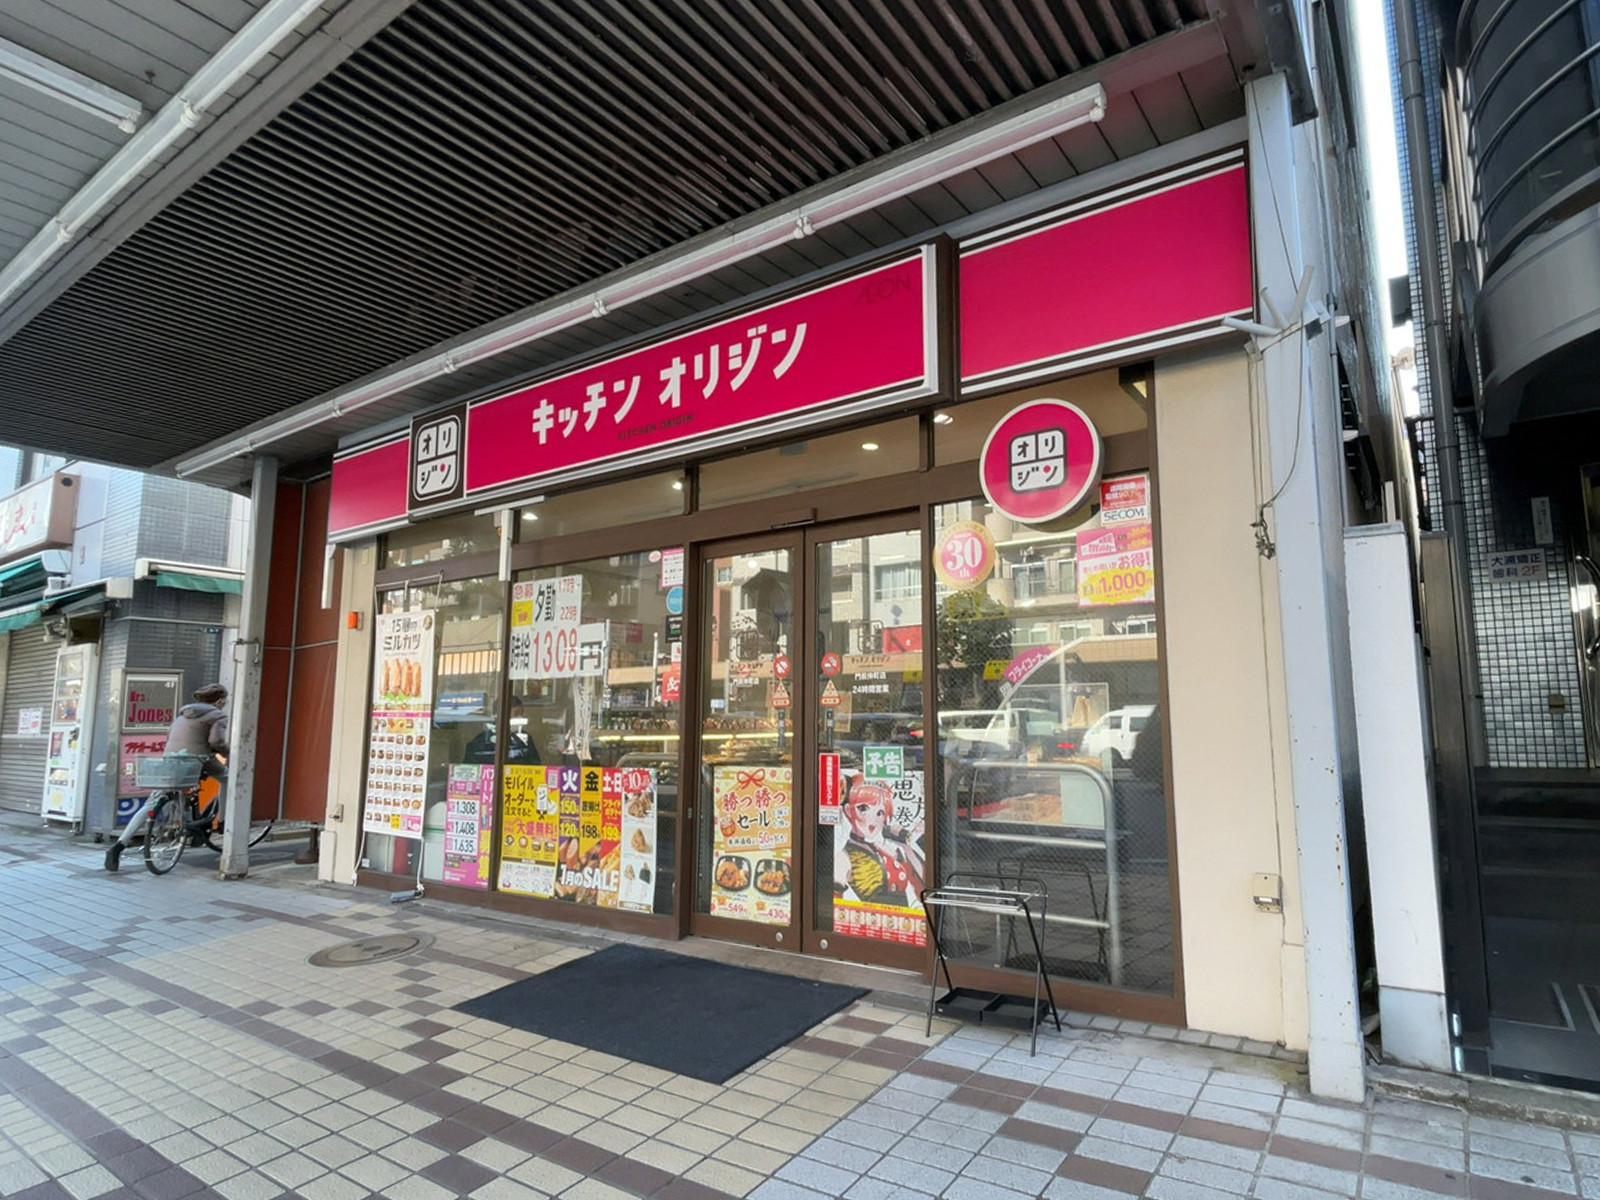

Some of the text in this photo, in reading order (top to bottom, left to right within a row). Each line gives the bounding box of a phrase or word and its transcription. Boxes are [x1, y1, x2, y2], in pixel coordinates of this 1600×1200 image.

[532, 322, 808, 445] キッチン オリジン
[617, 414, 694, 440] KITCHEN ORIGIN
[1104, 508, 1145, 521] SECOM
[946, 536, 983, 571] 30
[128, 703, 173, 723] Jones
[866, 751, 900, 775] 予告
[505, 775, 534, 791] モバイル
[562, 769, 579, 792] 火
[584, 771, 599, 792] 金
[723, 787, 786, 811] 勝つ勝つ
[737, 810, 770, 829] セール
